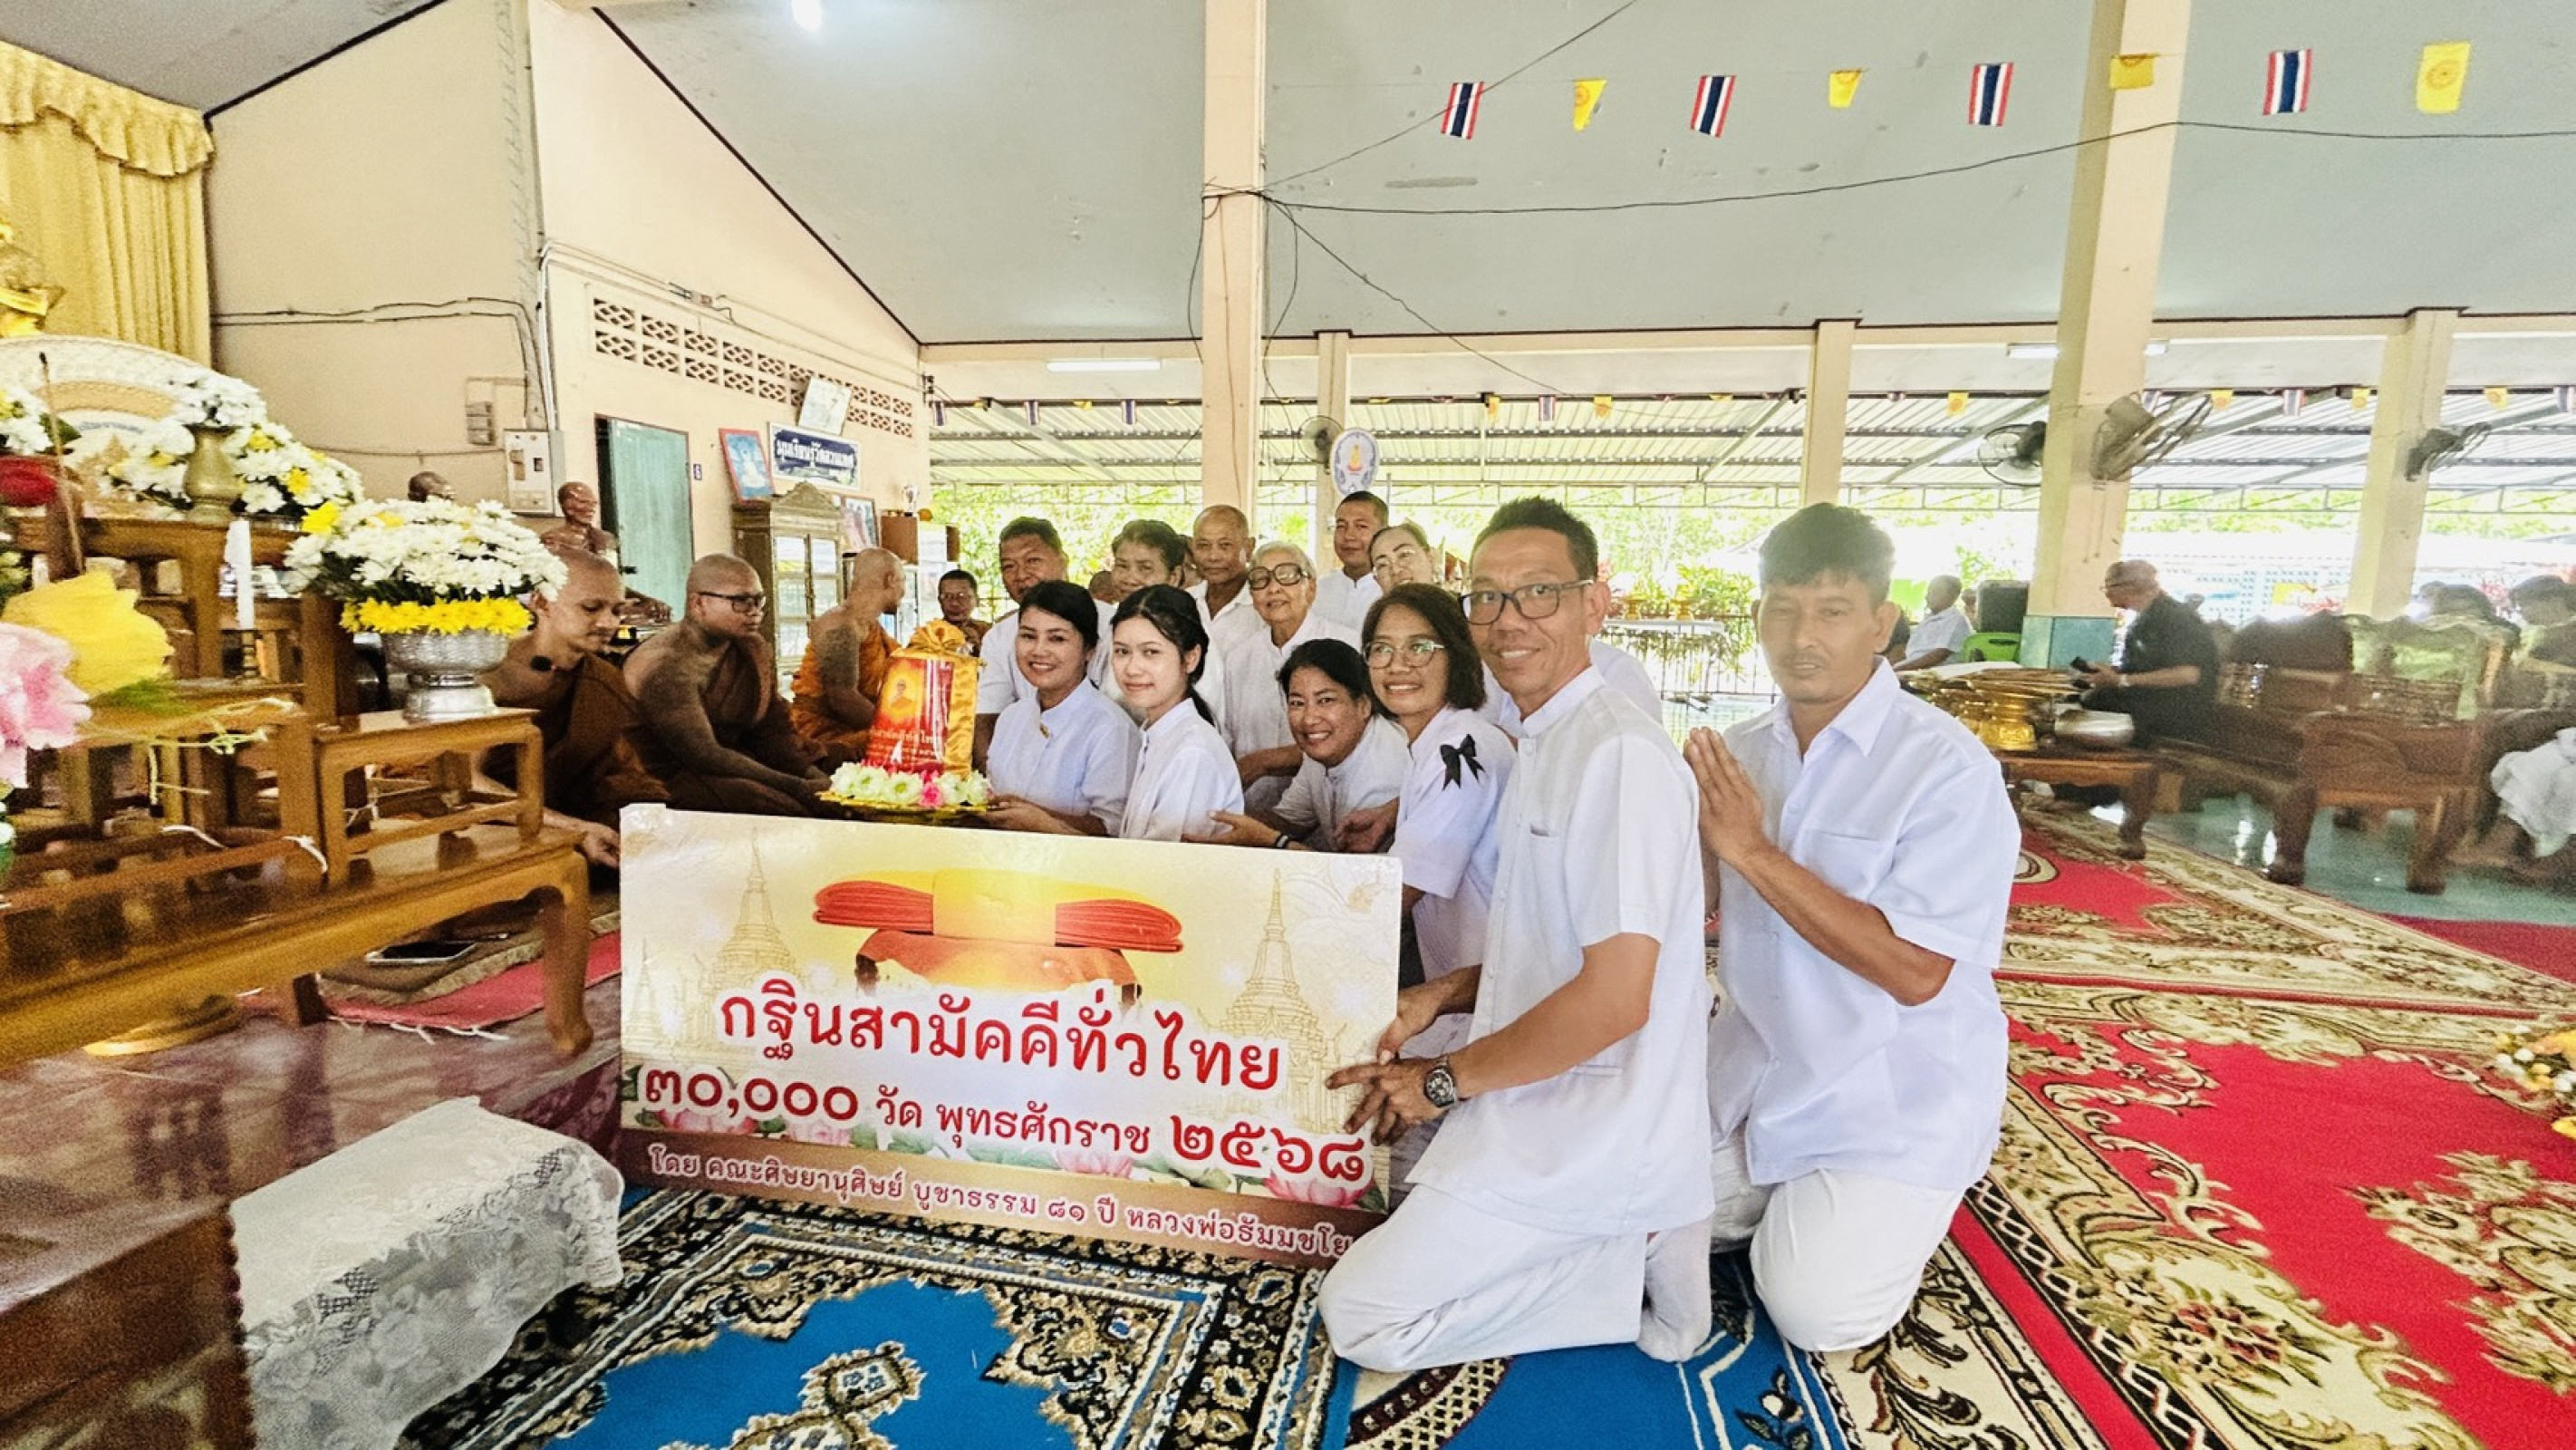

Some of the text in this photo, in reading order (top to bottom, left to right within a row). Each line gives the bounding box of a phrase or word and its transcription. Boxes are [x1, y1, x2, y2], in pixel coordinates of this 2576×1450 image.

[721, 978, 1278, 1091] กฐินสามัคคีทั่วไทย
[645, 1068, 1365, 1182] ๓๐,๐๐๐ วัด พุทธศักราช ๒๕๖๘
[650, 1144, 698, 1175] โดย
[707, 1159, 903, 1200] คณะศิษยานุศิษย์
[913, 1183, 1037, 1215] บูชาธรรม
[1047, 1200, 1085, 1222] ๘๑
[1096, 1195, 1116, 1224] ปี
